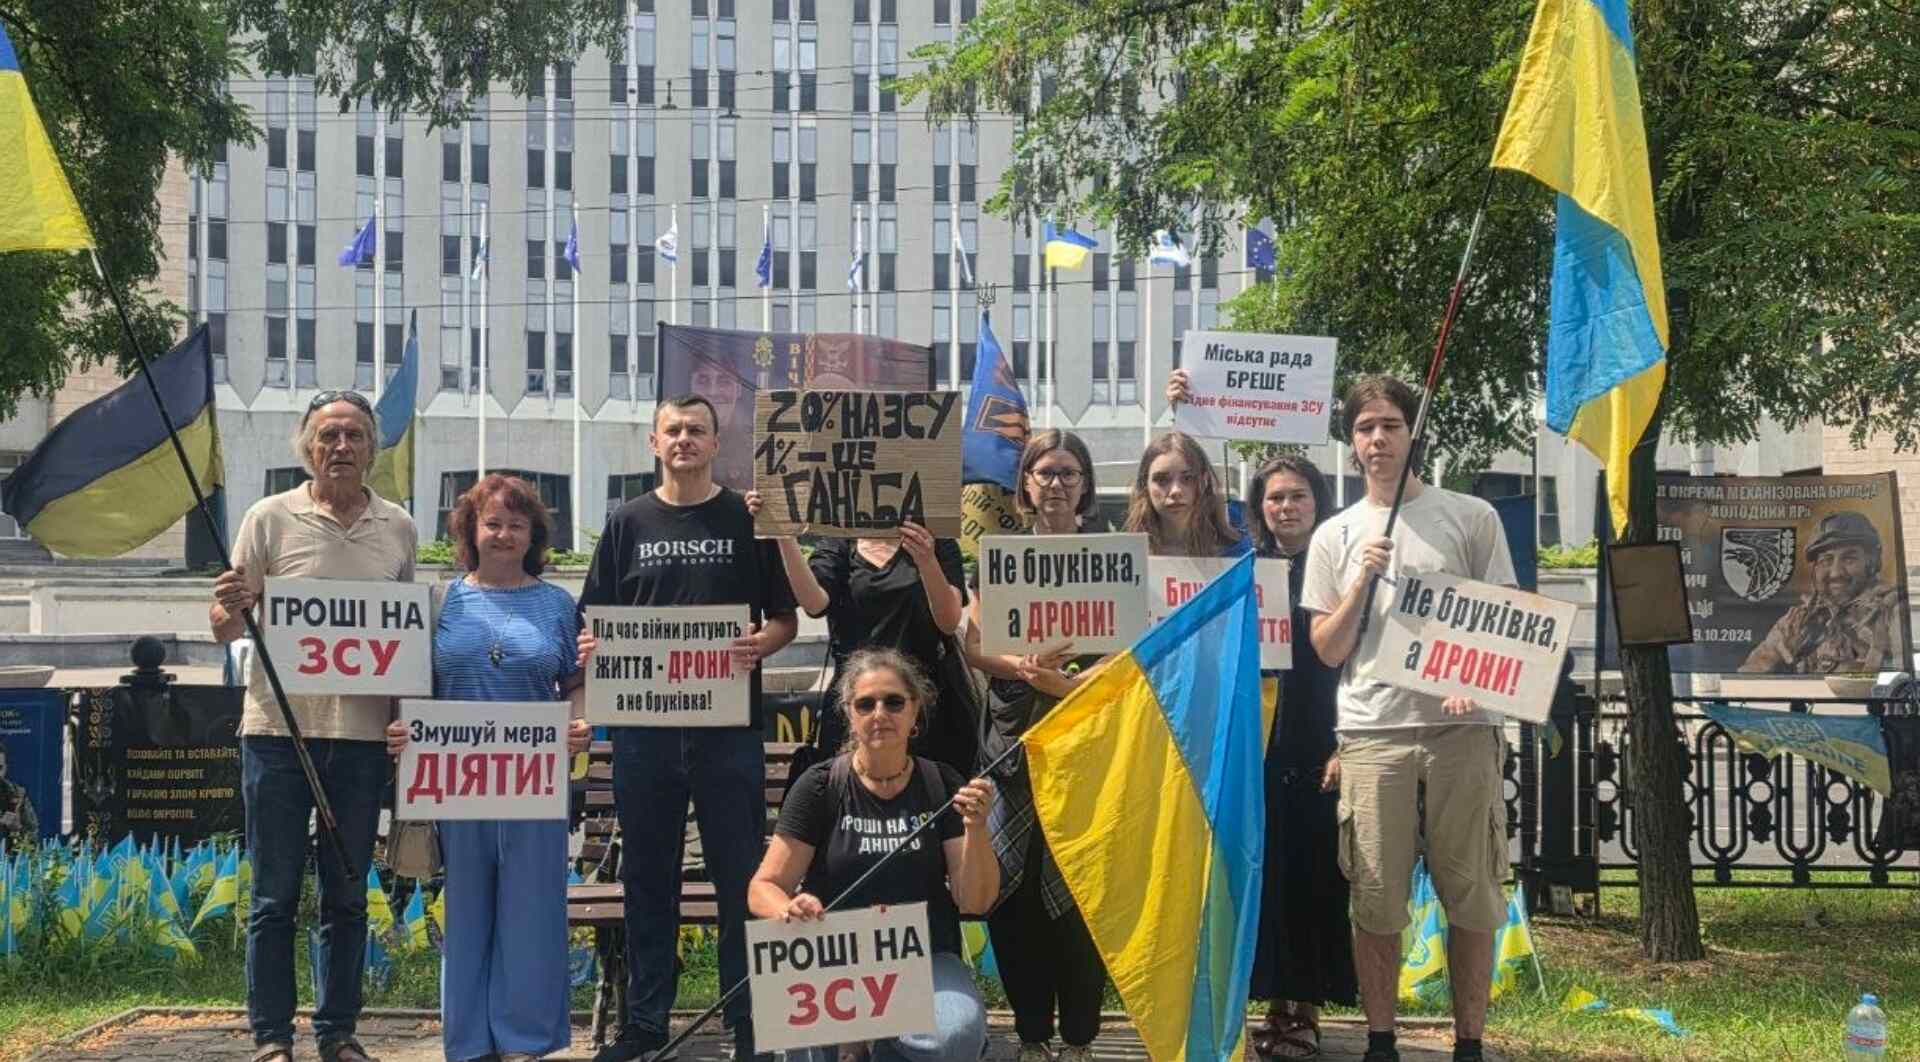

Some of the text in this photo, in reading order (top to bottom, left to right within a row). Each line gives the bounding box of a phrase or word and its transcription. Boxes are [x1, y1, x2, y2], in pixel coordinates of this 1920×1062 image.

[1205, 343, 1313, 369] Міська рада
[1226, 370, 1287, 391] БРЕШЕ
[1218, 394, 1298, 411] фінансування
[1301, 400, 1325, 415] ЗСУ
[1226, 413, 1277, 428] відсутнє
[755, 433, 797, 475] 1%
[832, 441, 877, 470] ЦЕ
[783, 466, 926, 529] ГАНЬБА
[1668, 485, 1724, 498] ОКРЕМА
[1727, 485, 1826, 499] МЕХАНІЗОВАНА
[639, 538, 735, 560] BORSCH
[988, 547, 1141, 588] Не бруківка,
[270, 597, 425, 629] ГРОШІ НА
[1008, 608, 1021, 638] а
[1027, 600, 1116, 643] ДРОНИ!
[1400, 578, 1559, 653] Не бруківка,
[592, 618, 742, 642] Під час війни рятують
[1693, 628, 1752, 642] 9.10.2024
[297, 637, 401, 677] ЗСУ
[595, 655, 653, 679] ЖИТТЯ
[668, 649, 735, 684] ДРОНИ,
[1405, 639, 1524, 696] а ДРОНИ!
[616, 690, 712, 713] а не бруківка!
[410, 719, 557, 747] Змушуй мера
[406, 752, 556, 804] ДІЯТИ!
[886, 817, 909, 835] НА
[858, 836, 921, 856] ДНІПО
[752, 926, 925, 976] ГРОШІ НА
[786, 973, 899, 1027] ЗСУ
